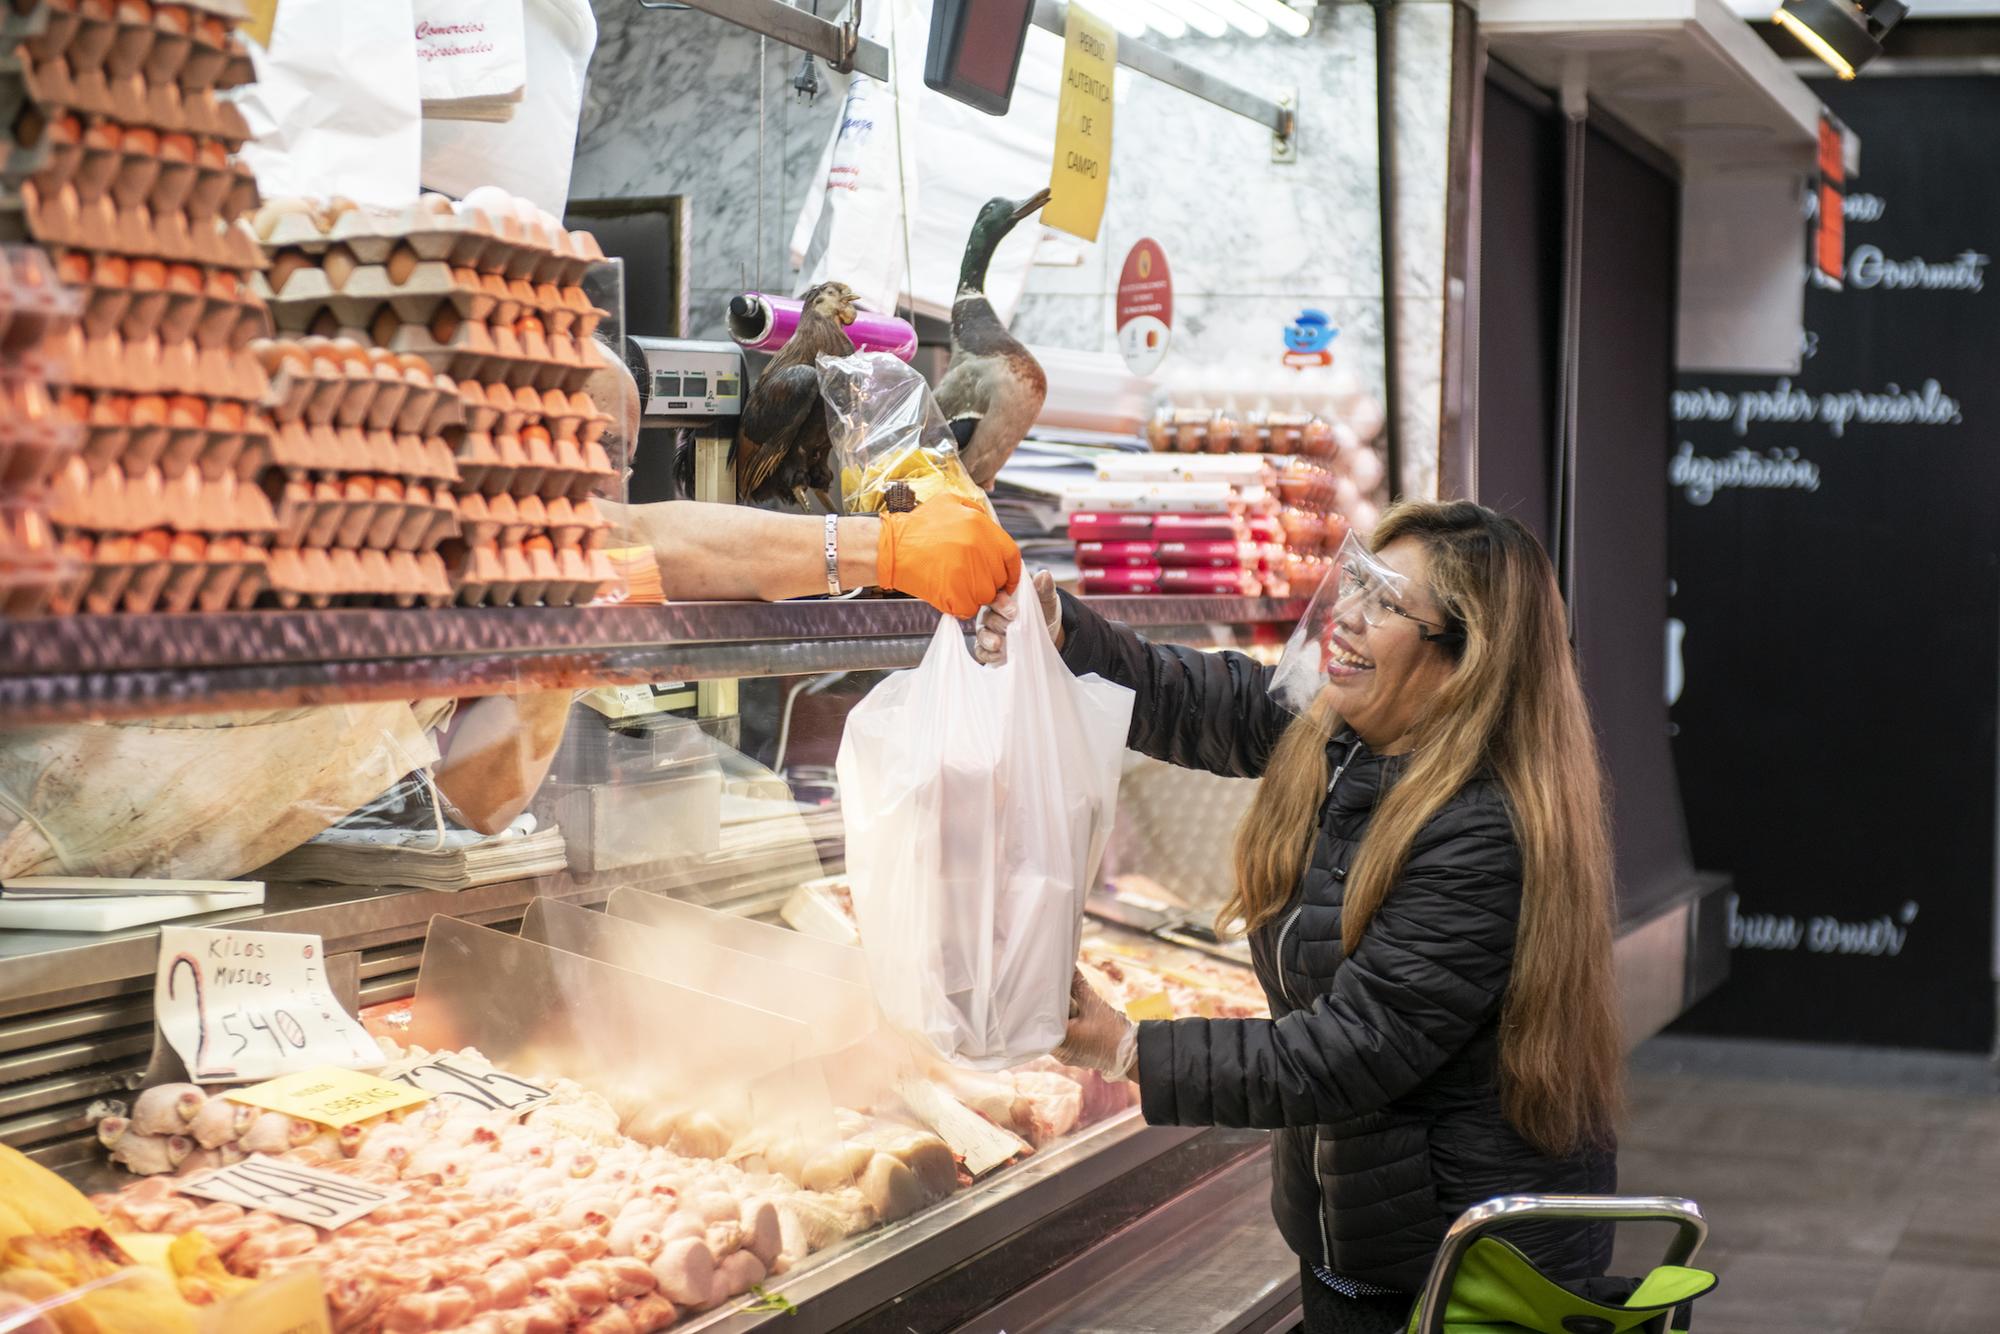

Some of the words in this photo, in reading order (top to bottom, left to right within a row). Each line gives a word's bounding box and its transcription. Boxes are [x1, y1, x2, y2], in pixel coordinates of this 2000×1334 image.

[415, 20, 485, 40] Comercios
[416, 41, 495, 62] rofesionales
[1079, 30, 1106, 61] PERDIZ
[1067, 67, 1111, 102] AUTENTICA
[1081, 114, 1094, 136] DE
[1066, 150, 1099, 180] CAMPO
[213, 966, 272, 988] MUSLOS
